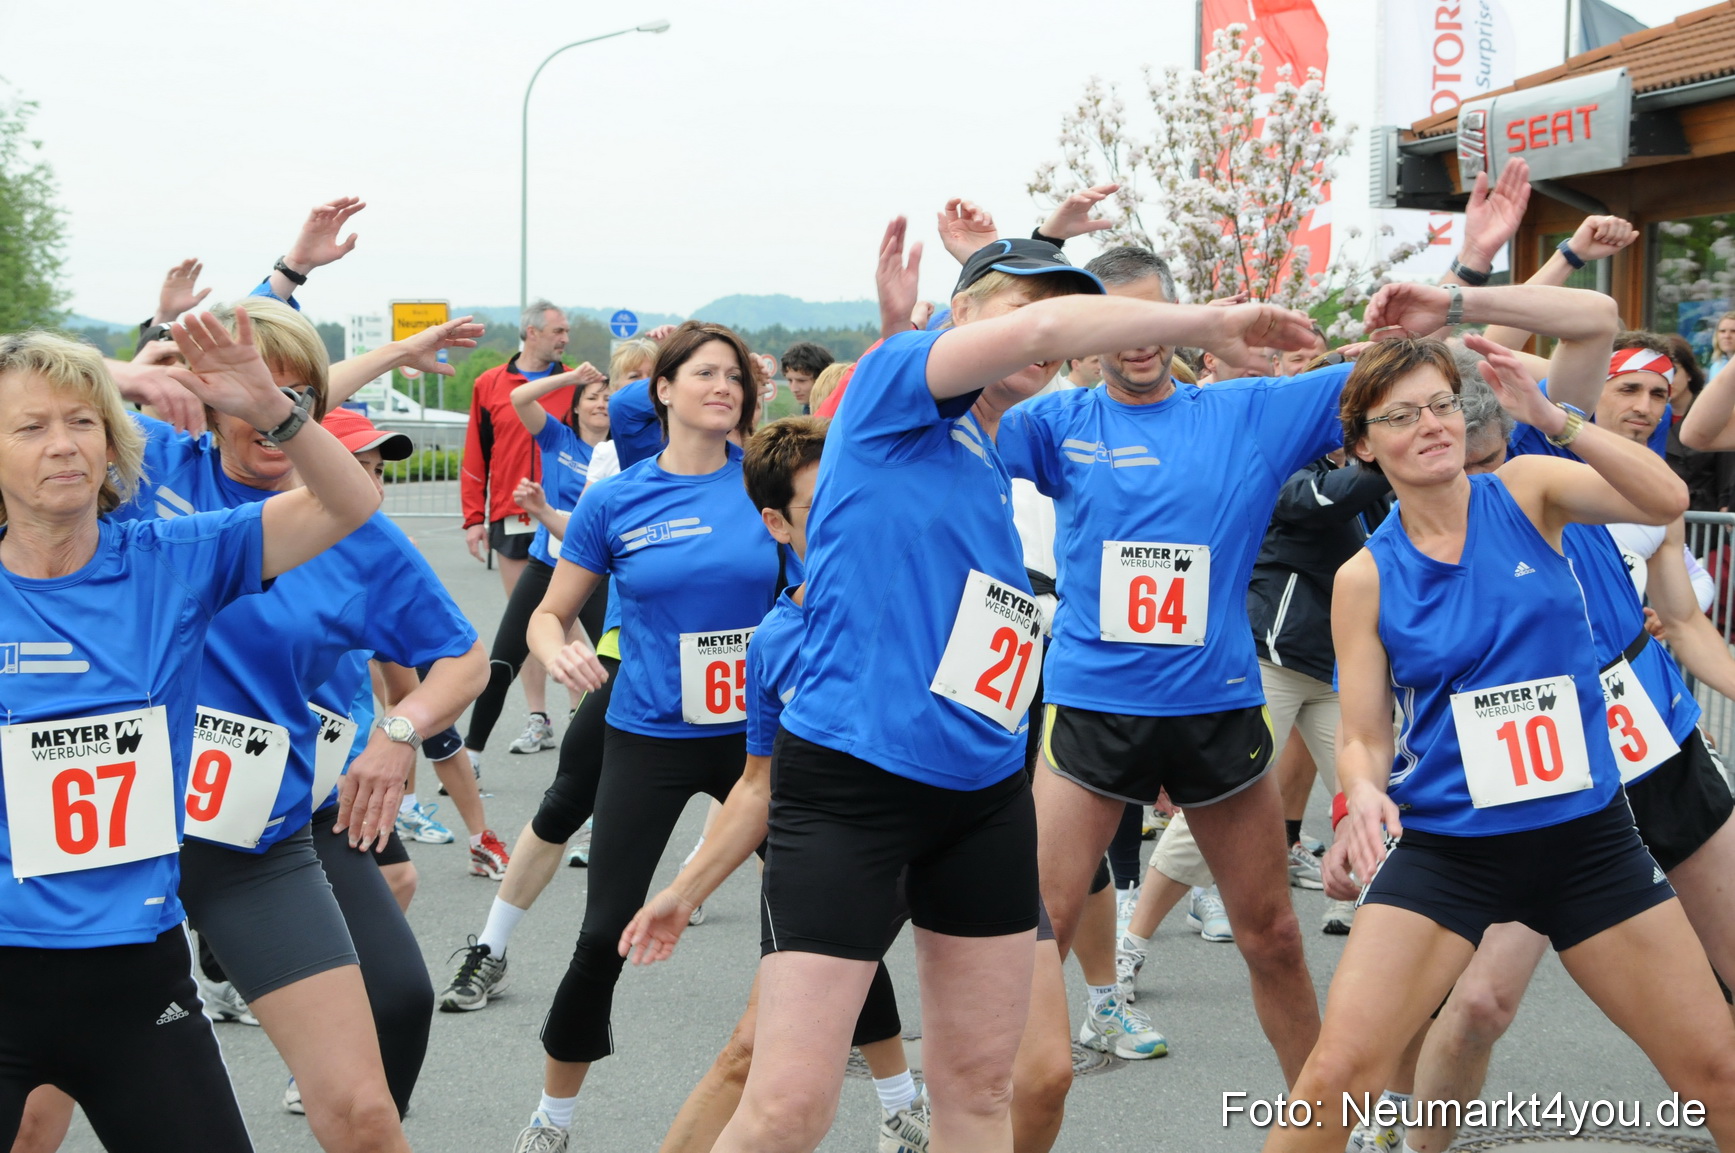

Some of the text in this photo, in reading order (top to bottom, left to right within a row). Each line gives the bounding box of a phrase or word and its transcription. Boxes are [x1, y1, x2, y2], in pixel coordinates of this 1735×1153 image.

[1430, 0, 1465, 117] OTOR
[1506, 103, 1598, 154] SEAT
[1120, 546, 1171, 560] MEYER
[1120, 558, 1171, 569] WERBUNG
[984, 598, 1031, 630] WERBUNG
[986, 584, 1035, 617] MEYER
[1128, 575, 1187, 634] 64
[697, 633, 742, 648] MEYER
[697, 645, 744, 656] WERBUNG
[974, 626, 1034, 711] 21
[1474, 687, 1533, 710] MEYER
[1475, 700, 1536, 719] WERBUNG
[31, 723, 109, 749] MEYER
[193, 728, 243, 749] ERBUNG
[1606, 704, 1648, 763] 3
[31, 741, 112, 761] WERBUNG
[1496, 714, 1564, 787] 10
[185, 749, 232, 822] 9
[52, 761, 136, 855] 67
[156, 1009, 190, 1026] adidas
